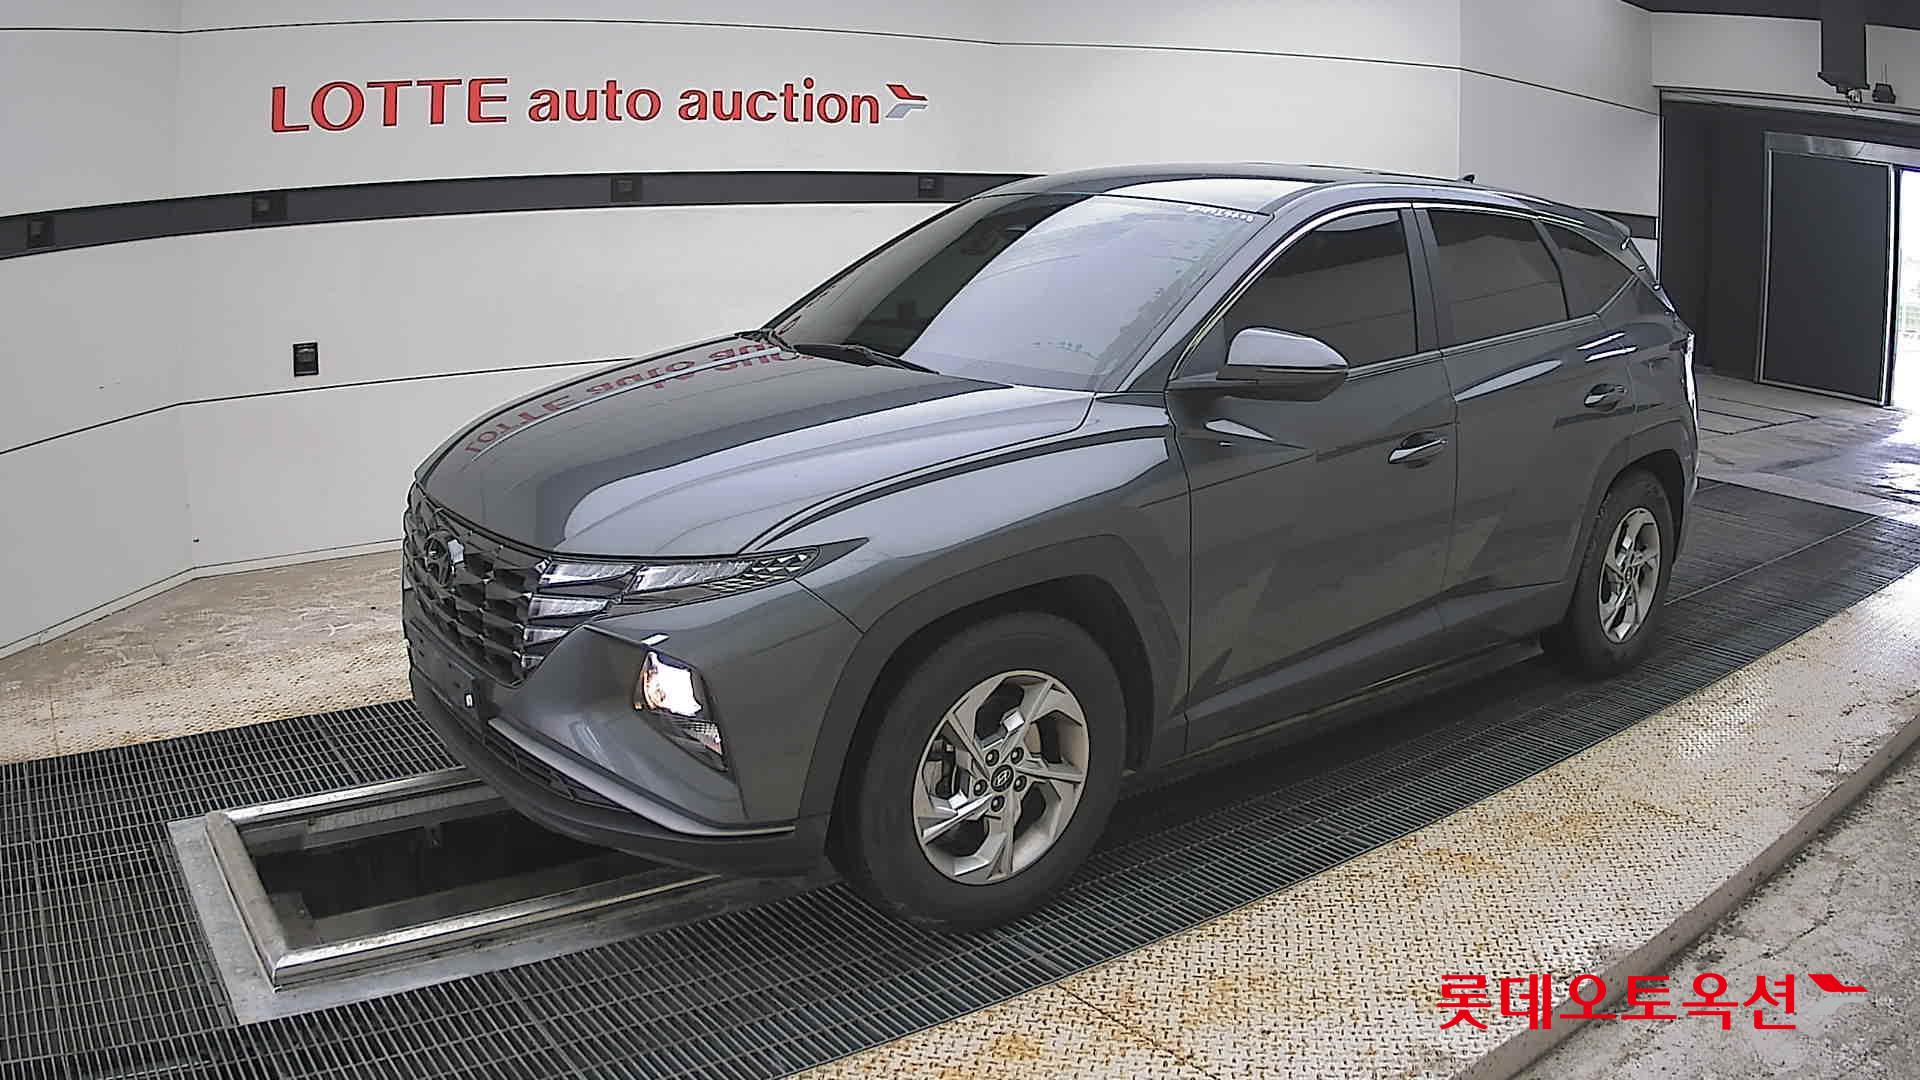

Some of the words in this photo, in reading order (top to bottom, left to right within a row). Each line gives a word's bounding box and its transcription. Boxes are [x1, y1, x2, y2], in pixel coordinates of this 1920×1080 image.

[271, 77, 508, 133] LOTTE
[528, 79, 662, 122] auto
[678, 77, 880, 124] auction
